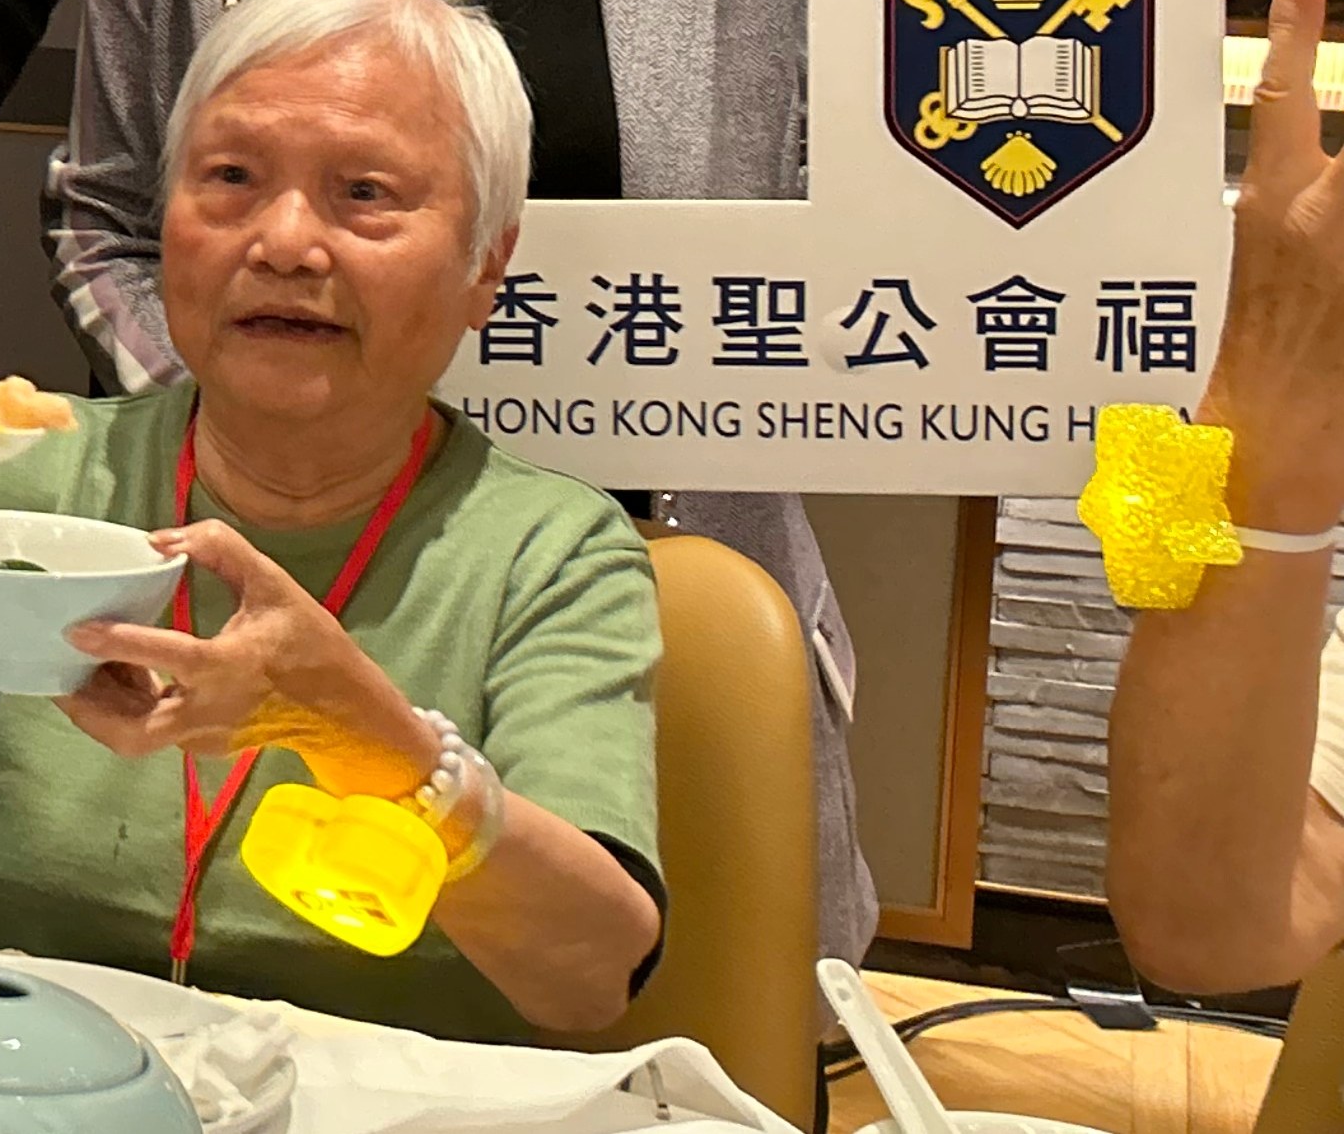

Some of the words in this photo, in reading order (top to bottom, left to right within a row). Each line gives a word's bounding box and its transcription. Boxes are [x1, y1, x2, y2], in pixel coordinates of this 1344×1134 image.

[479, 272, 1198, 374] 香港聖公會福
[462, 396, 596, 436] HONG
[612, 399, 741, 439] KONG
[756, 401, 904, 440] SHENG
[921, 403, 1050, 442] KUNG
